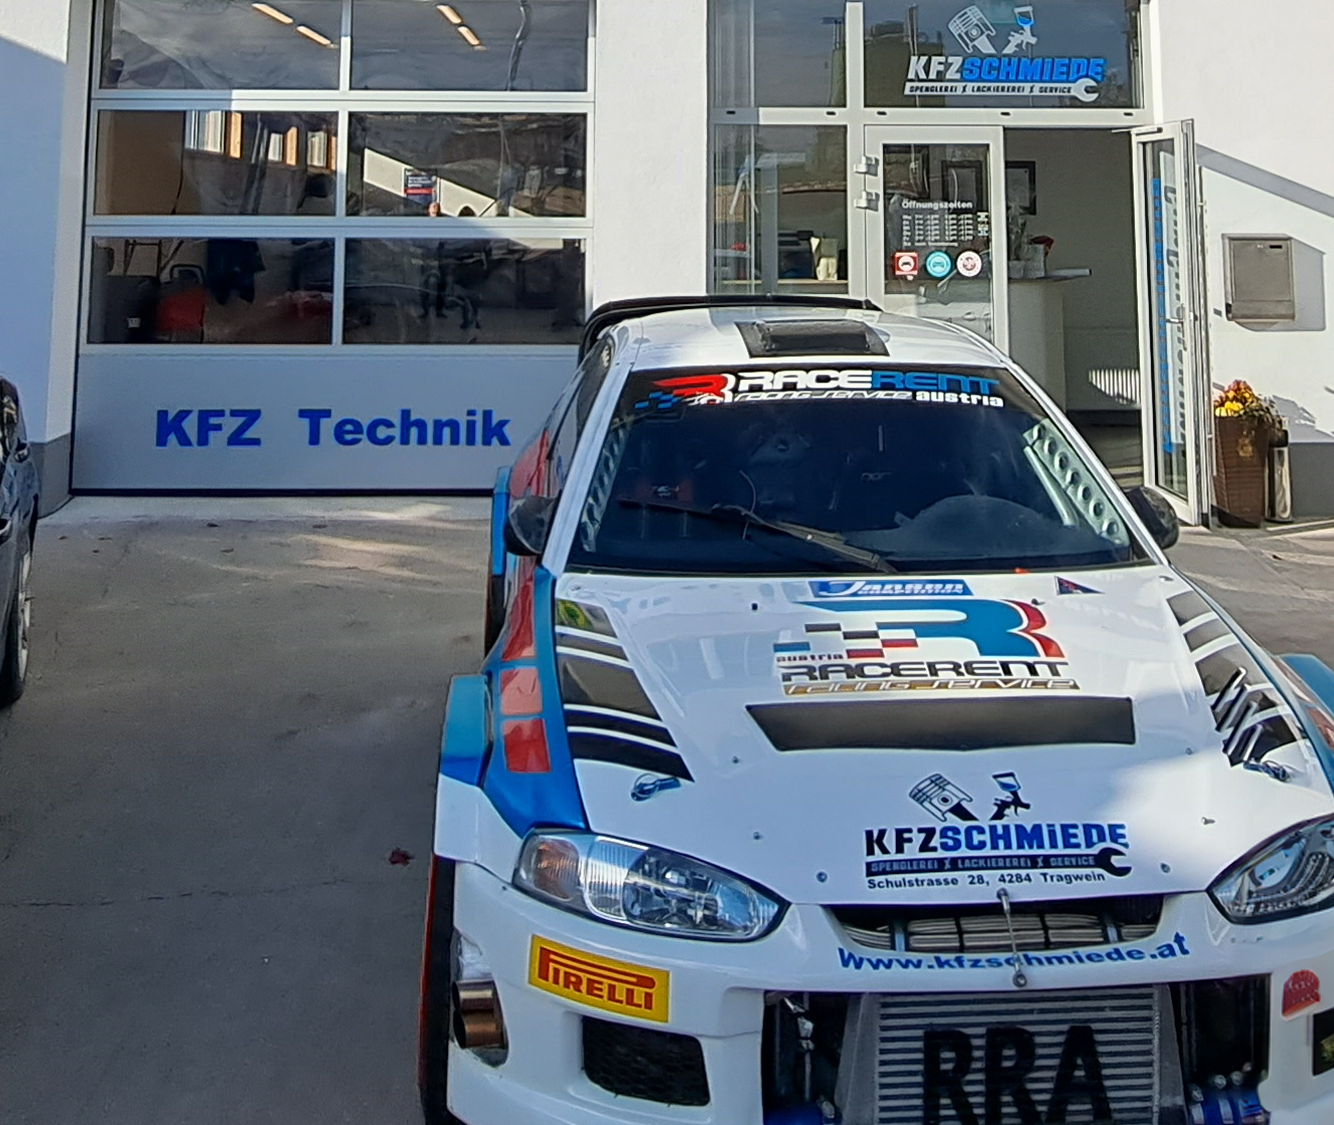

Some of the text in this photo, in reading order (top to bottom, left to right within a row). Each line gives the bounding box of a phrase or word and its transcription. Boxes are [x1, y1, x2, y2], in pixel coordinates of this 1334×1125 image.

[901, 198, 973, 210] Öffnungszeiten
[916, 391, 1004, 407] austria
[155, 408, 511, 447] KFZ Technik
[781, 660, 1069, 684] RACERENT
[867, 871, 1106, 890] Schulstrasse 28, 4284 Tragwein
[538, 946, 656, 1010] PIRELLI
[923, 1025, 1113, 1125] RRA
